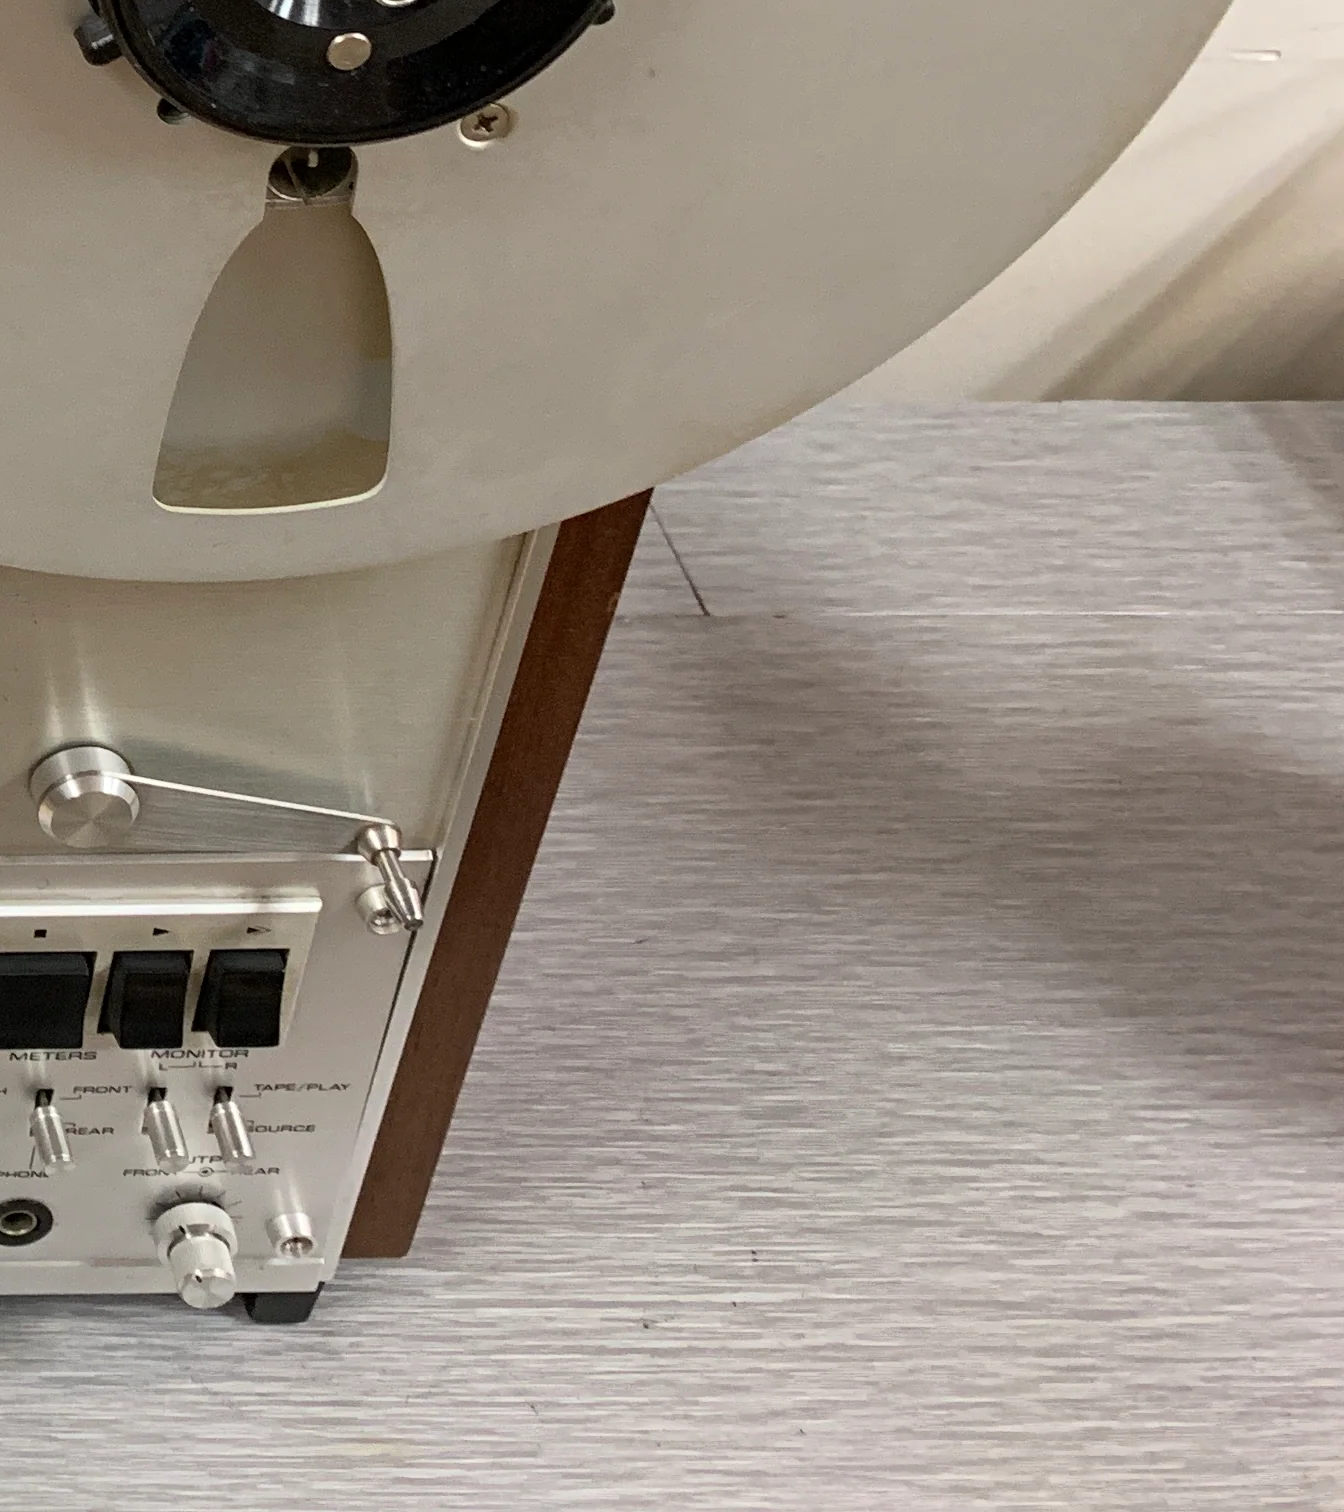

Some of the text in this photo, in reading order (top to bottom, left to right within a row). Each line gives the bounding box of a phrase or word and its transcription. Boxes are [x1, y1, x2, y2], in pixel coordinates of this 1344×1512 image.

[9, 1051, 98, 1061] METERS
[151, 1048, 250, 1059] MONITOR
[72, 1085, 133, 1094] FRONT
[254, 1083, 352, 1092] TAPE/PLAY
